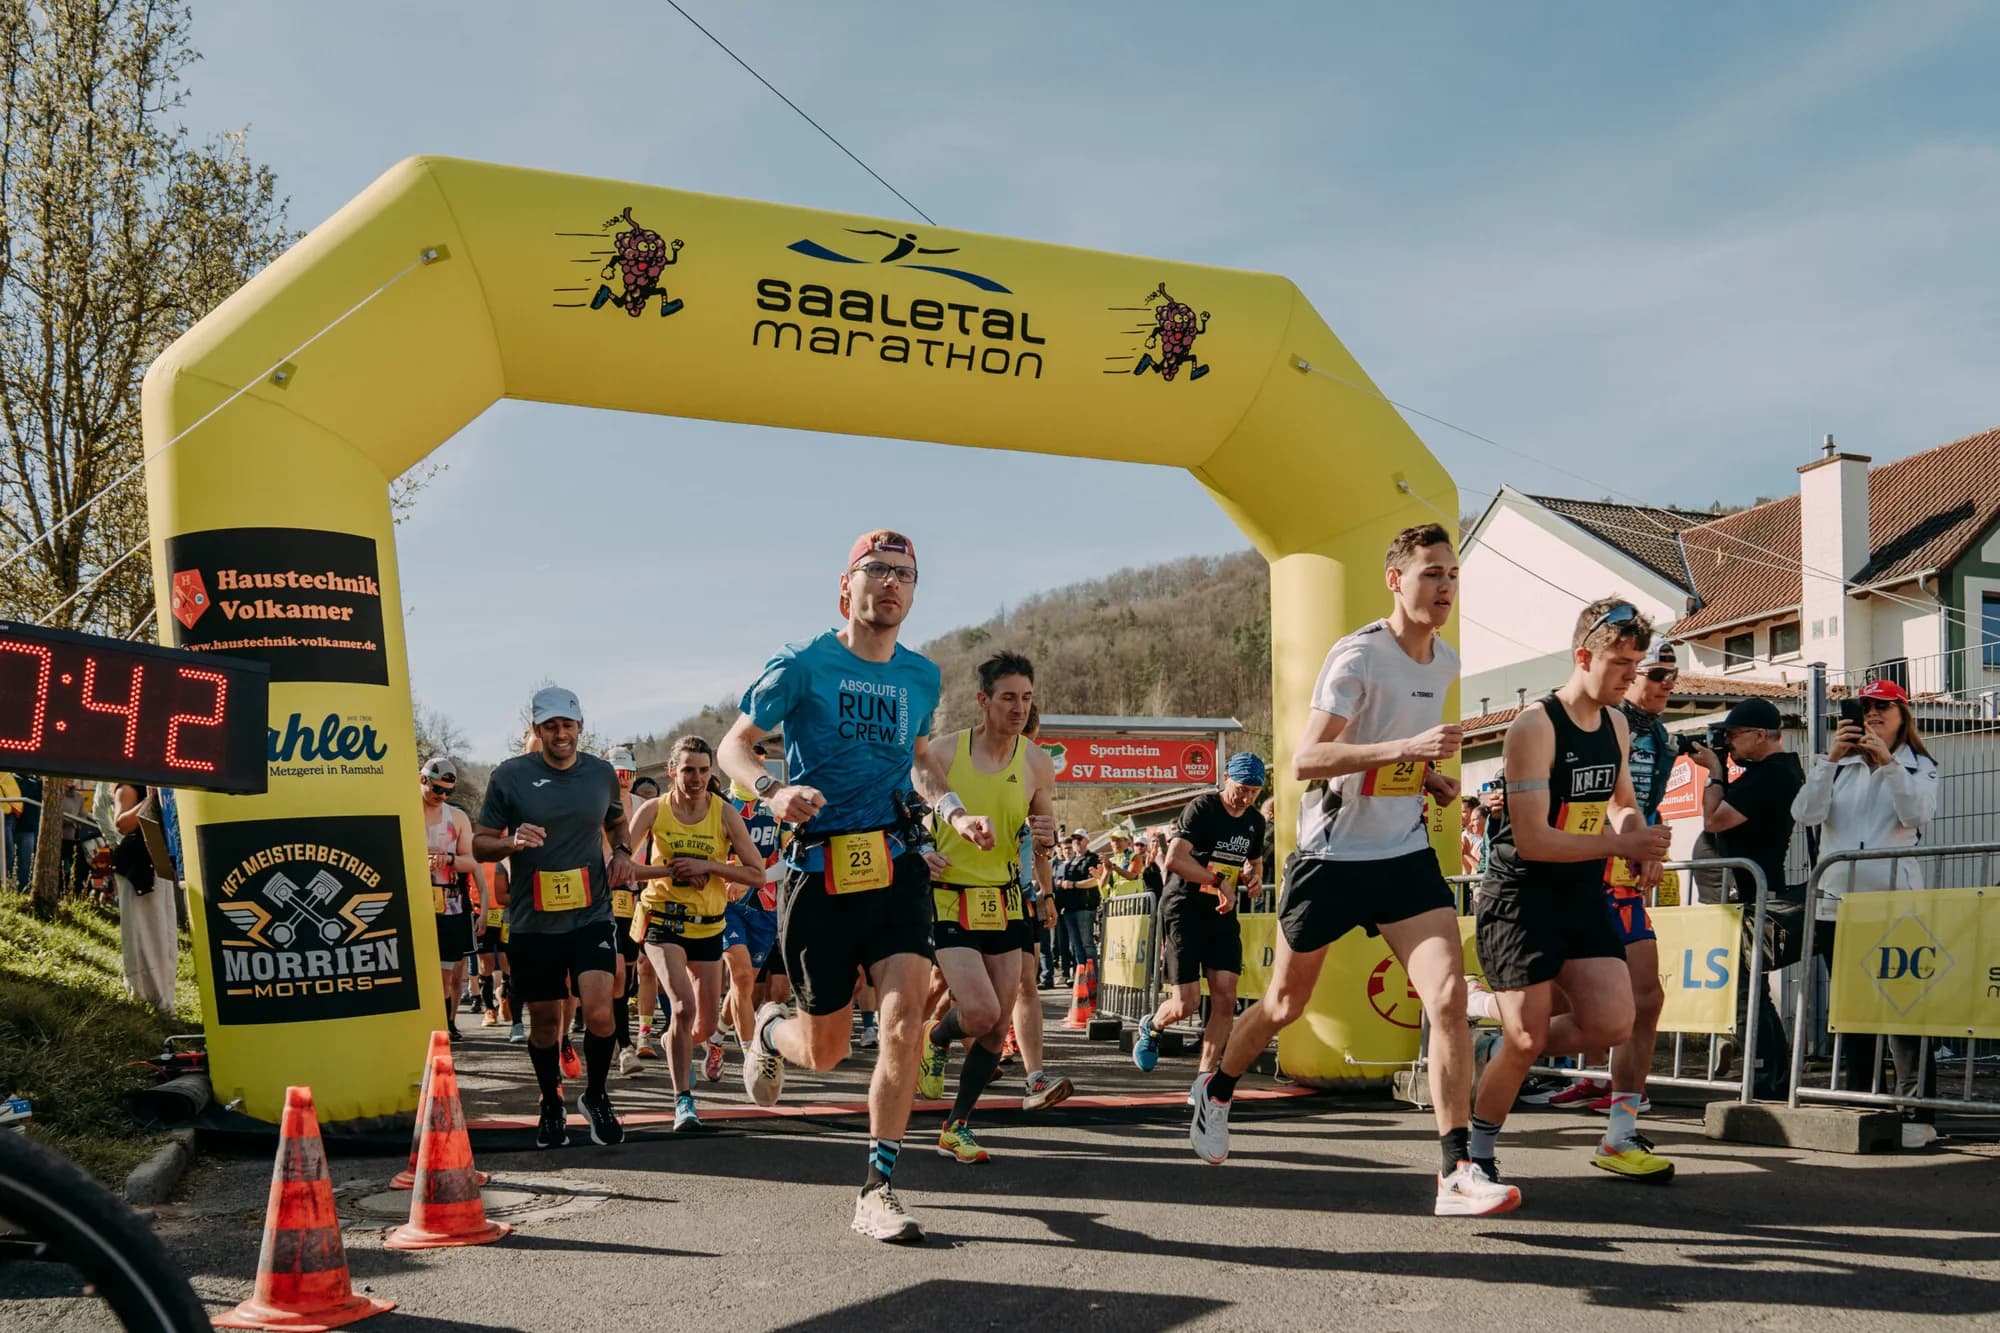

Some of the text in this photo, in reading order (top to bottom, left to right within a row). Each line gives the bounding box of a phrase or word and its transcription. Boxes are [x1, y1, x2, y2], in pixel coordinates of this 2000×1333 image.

[217, 569, 380, 596] Haustechnik
[219, 600, 354, 622] Volkamer
[839, 679, 897, 697] ABSOLUTE
[839, 692, 897, 724] RUN
[838, 721, 897, 744] CREW
[1089, 744, 1160, 758] Sportheim
[270, 764, 385, 778] Metzgerei in Ramsthal
[1072, 764, 1178, 779] SV Ramsthal
[1394, 761, 1415, 776] 24
[1578, 817, 1599, 832] 47
[1215, 841, 1249, 855] SPORTS
[850, 850, 872, 867] 23
[221, 843, 382, 898] KFZ MEISTERBETRIEB
[554, 883, 569, 894] 11
[980, 900, 997, 912] 15
[222, 938, 400, 982] MORRIEN
[1683, 947, 1729, 990] LS
[1876, 946, 1936, 980] DC
[254, 976, 373, 998] MOTORS
